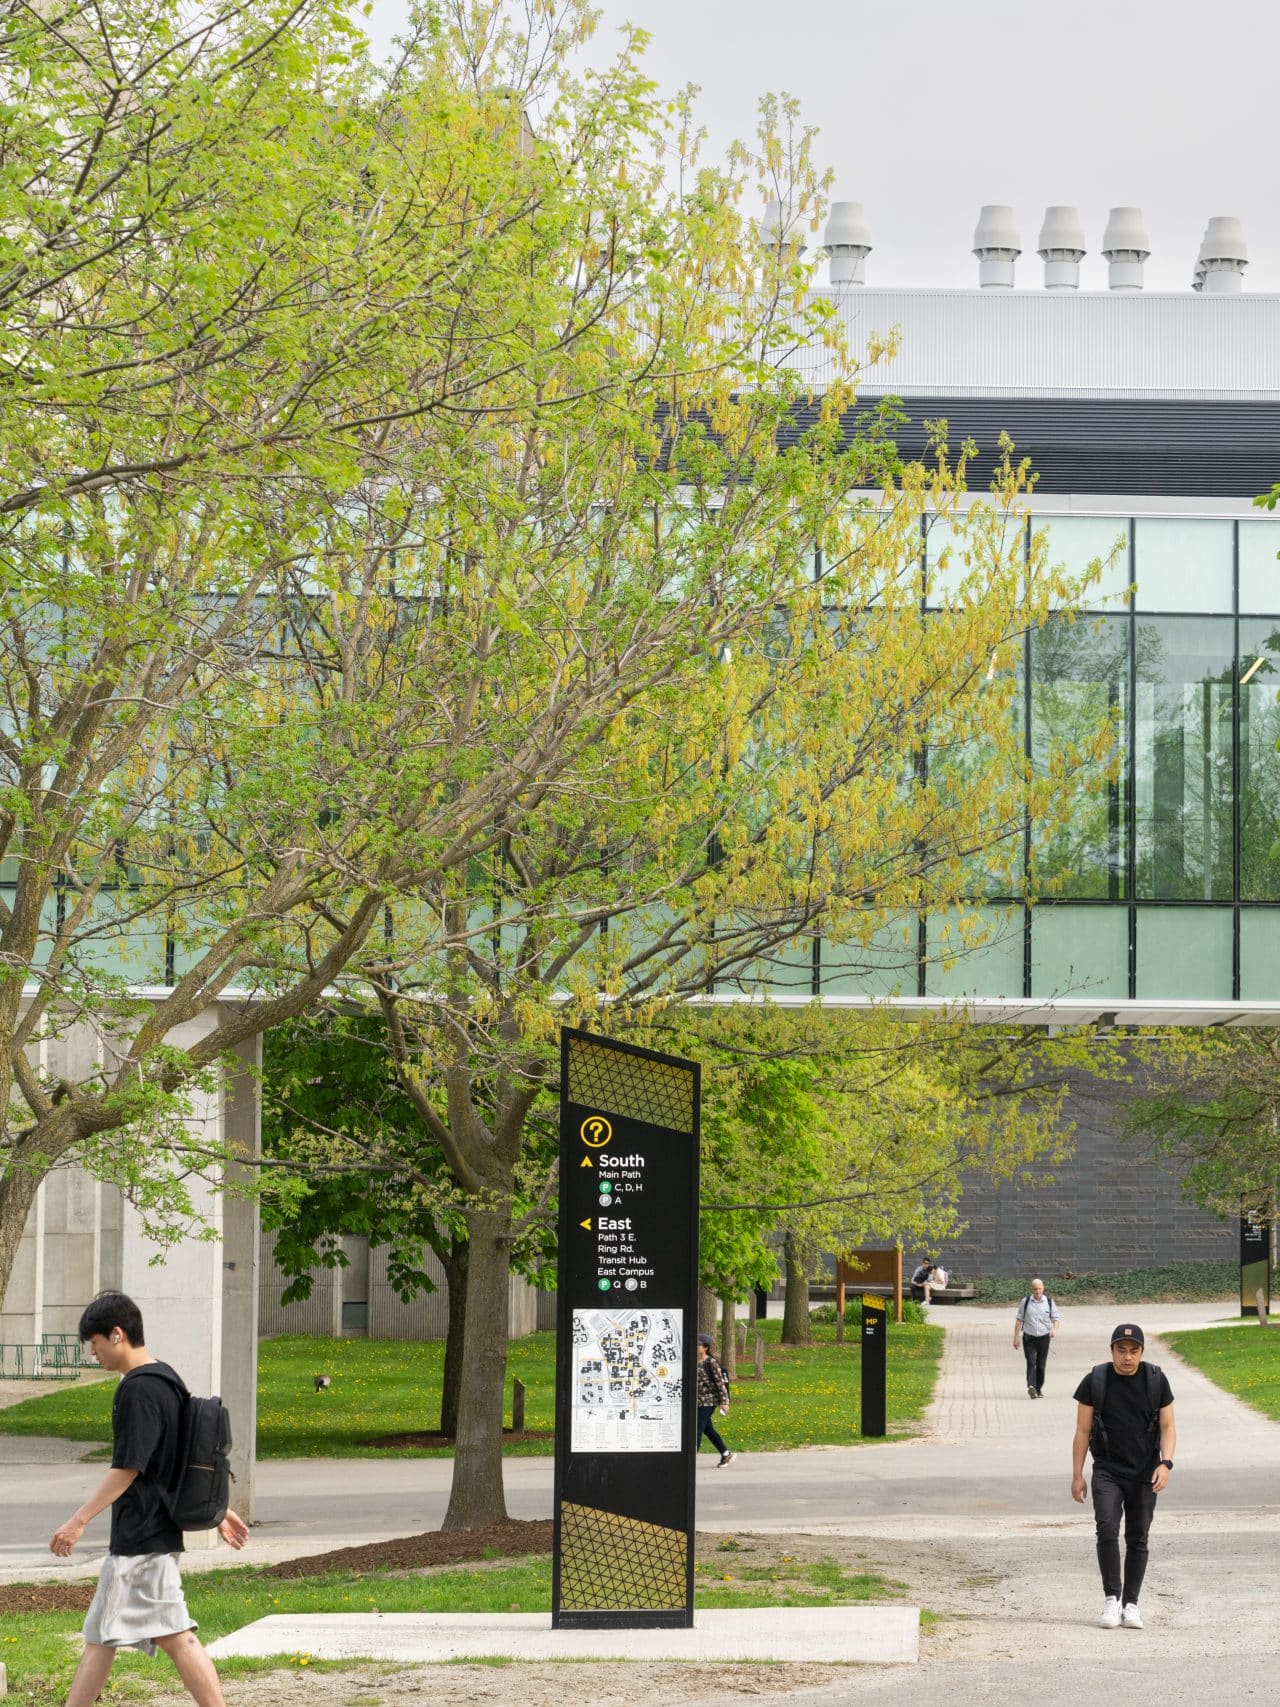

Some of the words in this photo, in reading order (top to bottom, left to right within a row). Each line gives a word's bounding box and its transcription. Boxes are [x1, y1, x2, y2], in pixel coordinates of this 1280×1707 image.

[599, 1154, 645, 1167] South
[599, 1171, 619, 1179] Main
[622, 1171, 641, 1179] Path
[614, 1183, 624, 1192] C,
[625, 1183, 635, 1192] D,
[635, 1183, 643, 1191] H
[615, 1196, 622, 1204] A
[598, 1217, 632, 1230] East
[598, 1233, 618, 1242] Path
[619, 1233, 626, 1241] 3
[628, 1233, 637, 1241] E.
[598, 1244, 618, 1254] Ring
[619, 1244, 635, 1253] Rd.
[598, 1256, 627, 1264] Transit
[629, 1256, 647, 1264] Hub
[597, 1267, 617, 1276] East
[619, 1267, 655, 1277] Campus
[613, 1280, 622, 1289] Q
[640, 1280, 647, 1288] B
